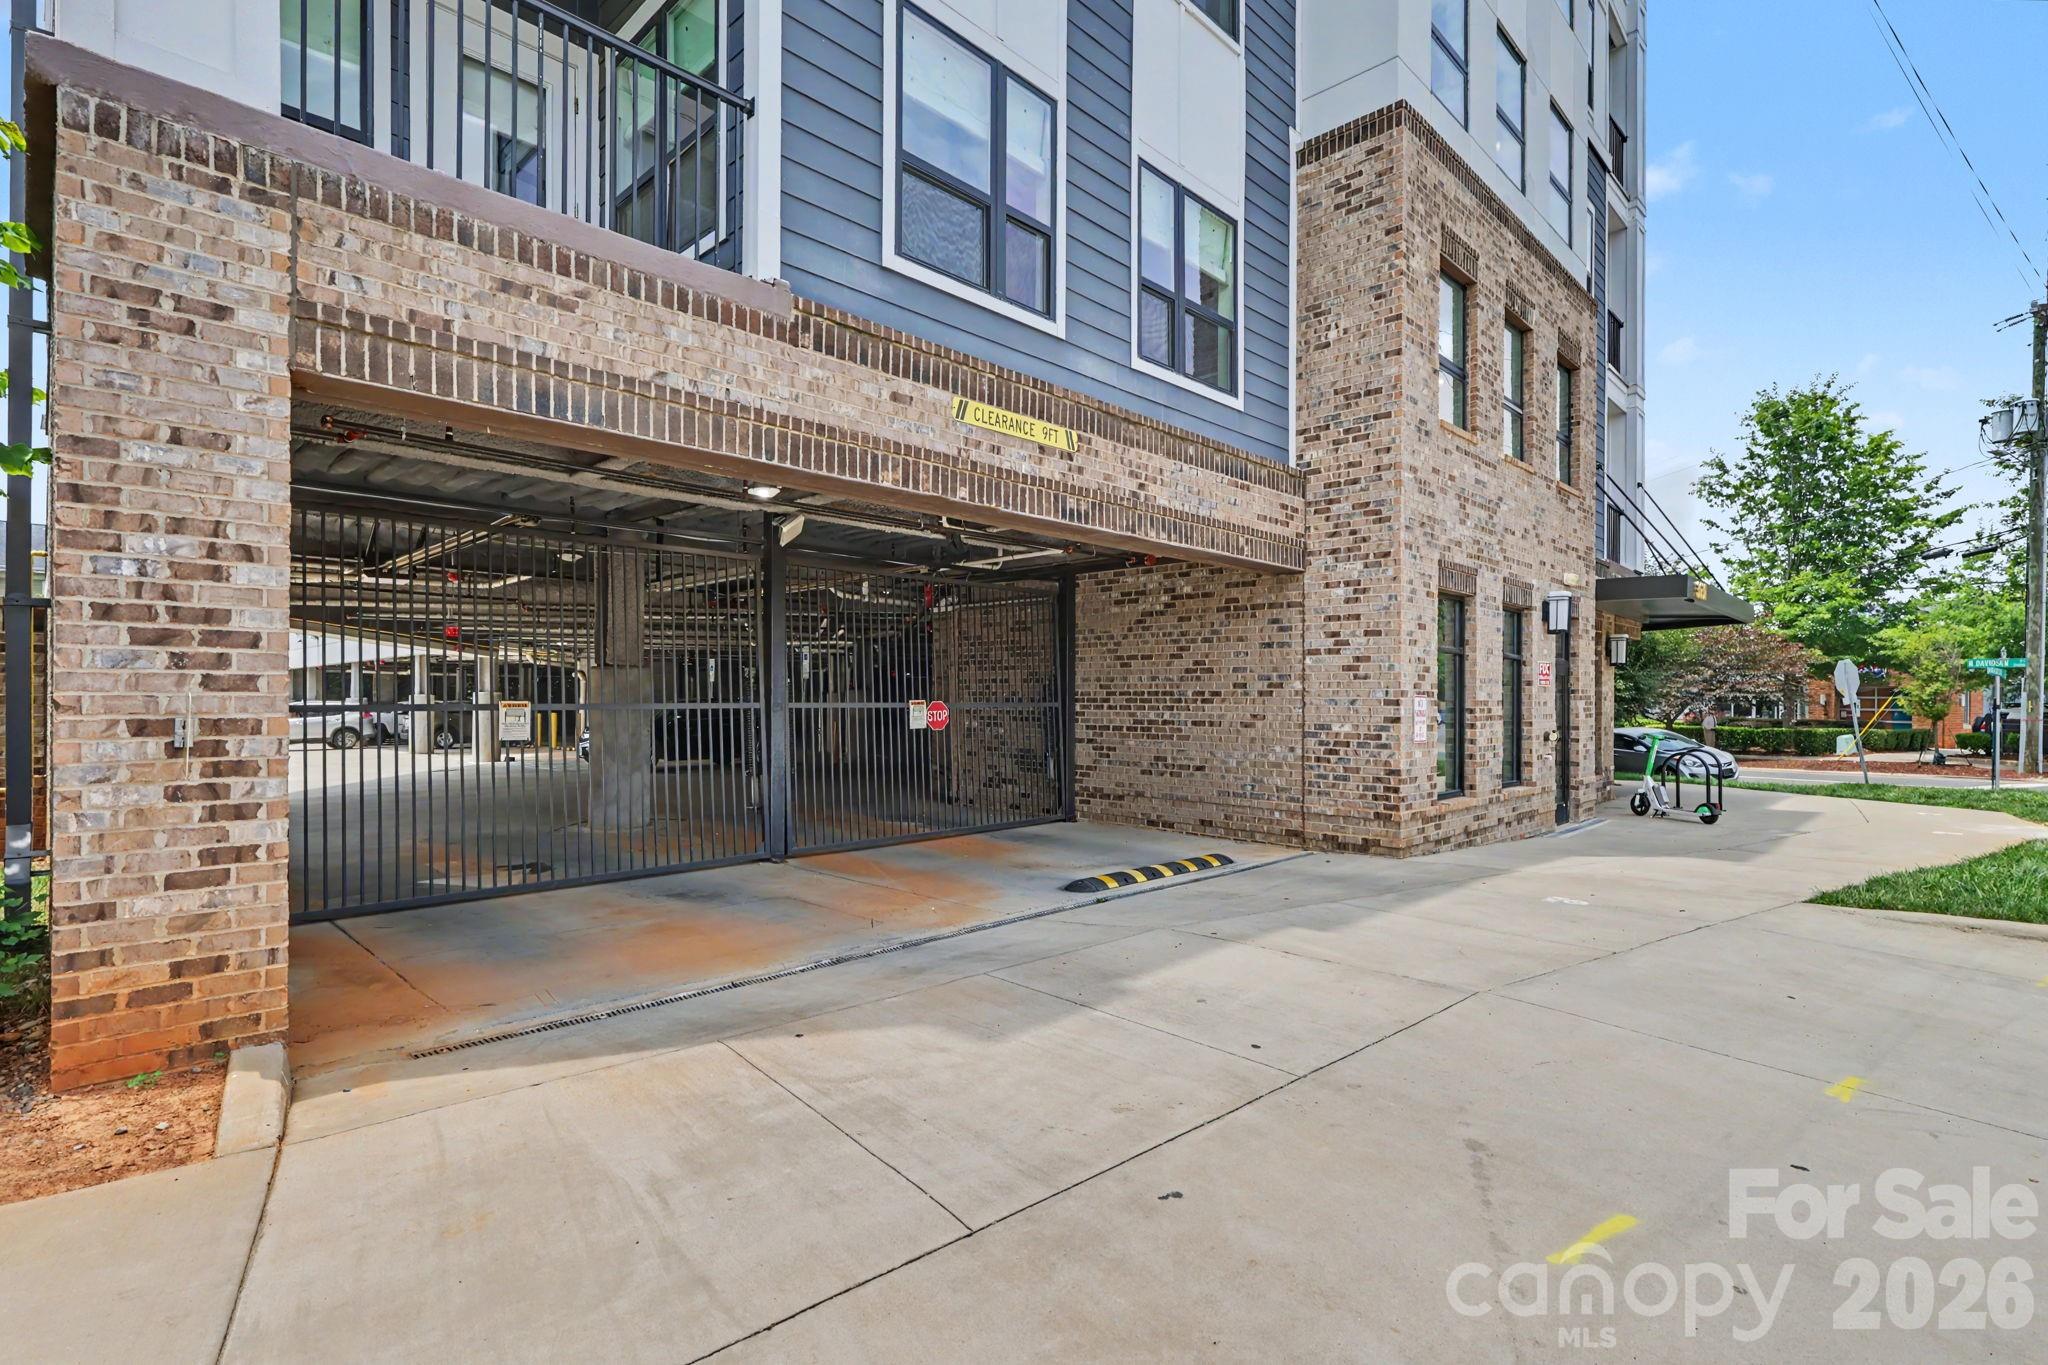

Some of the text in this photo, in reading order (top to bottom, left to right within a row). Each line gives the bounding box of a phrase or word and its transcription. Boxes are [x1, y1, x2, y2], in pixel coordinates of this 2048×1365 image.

[973, 406, 1059, 444] CLEARANCE 9FT
[927, 710, 948, 722] STOP
